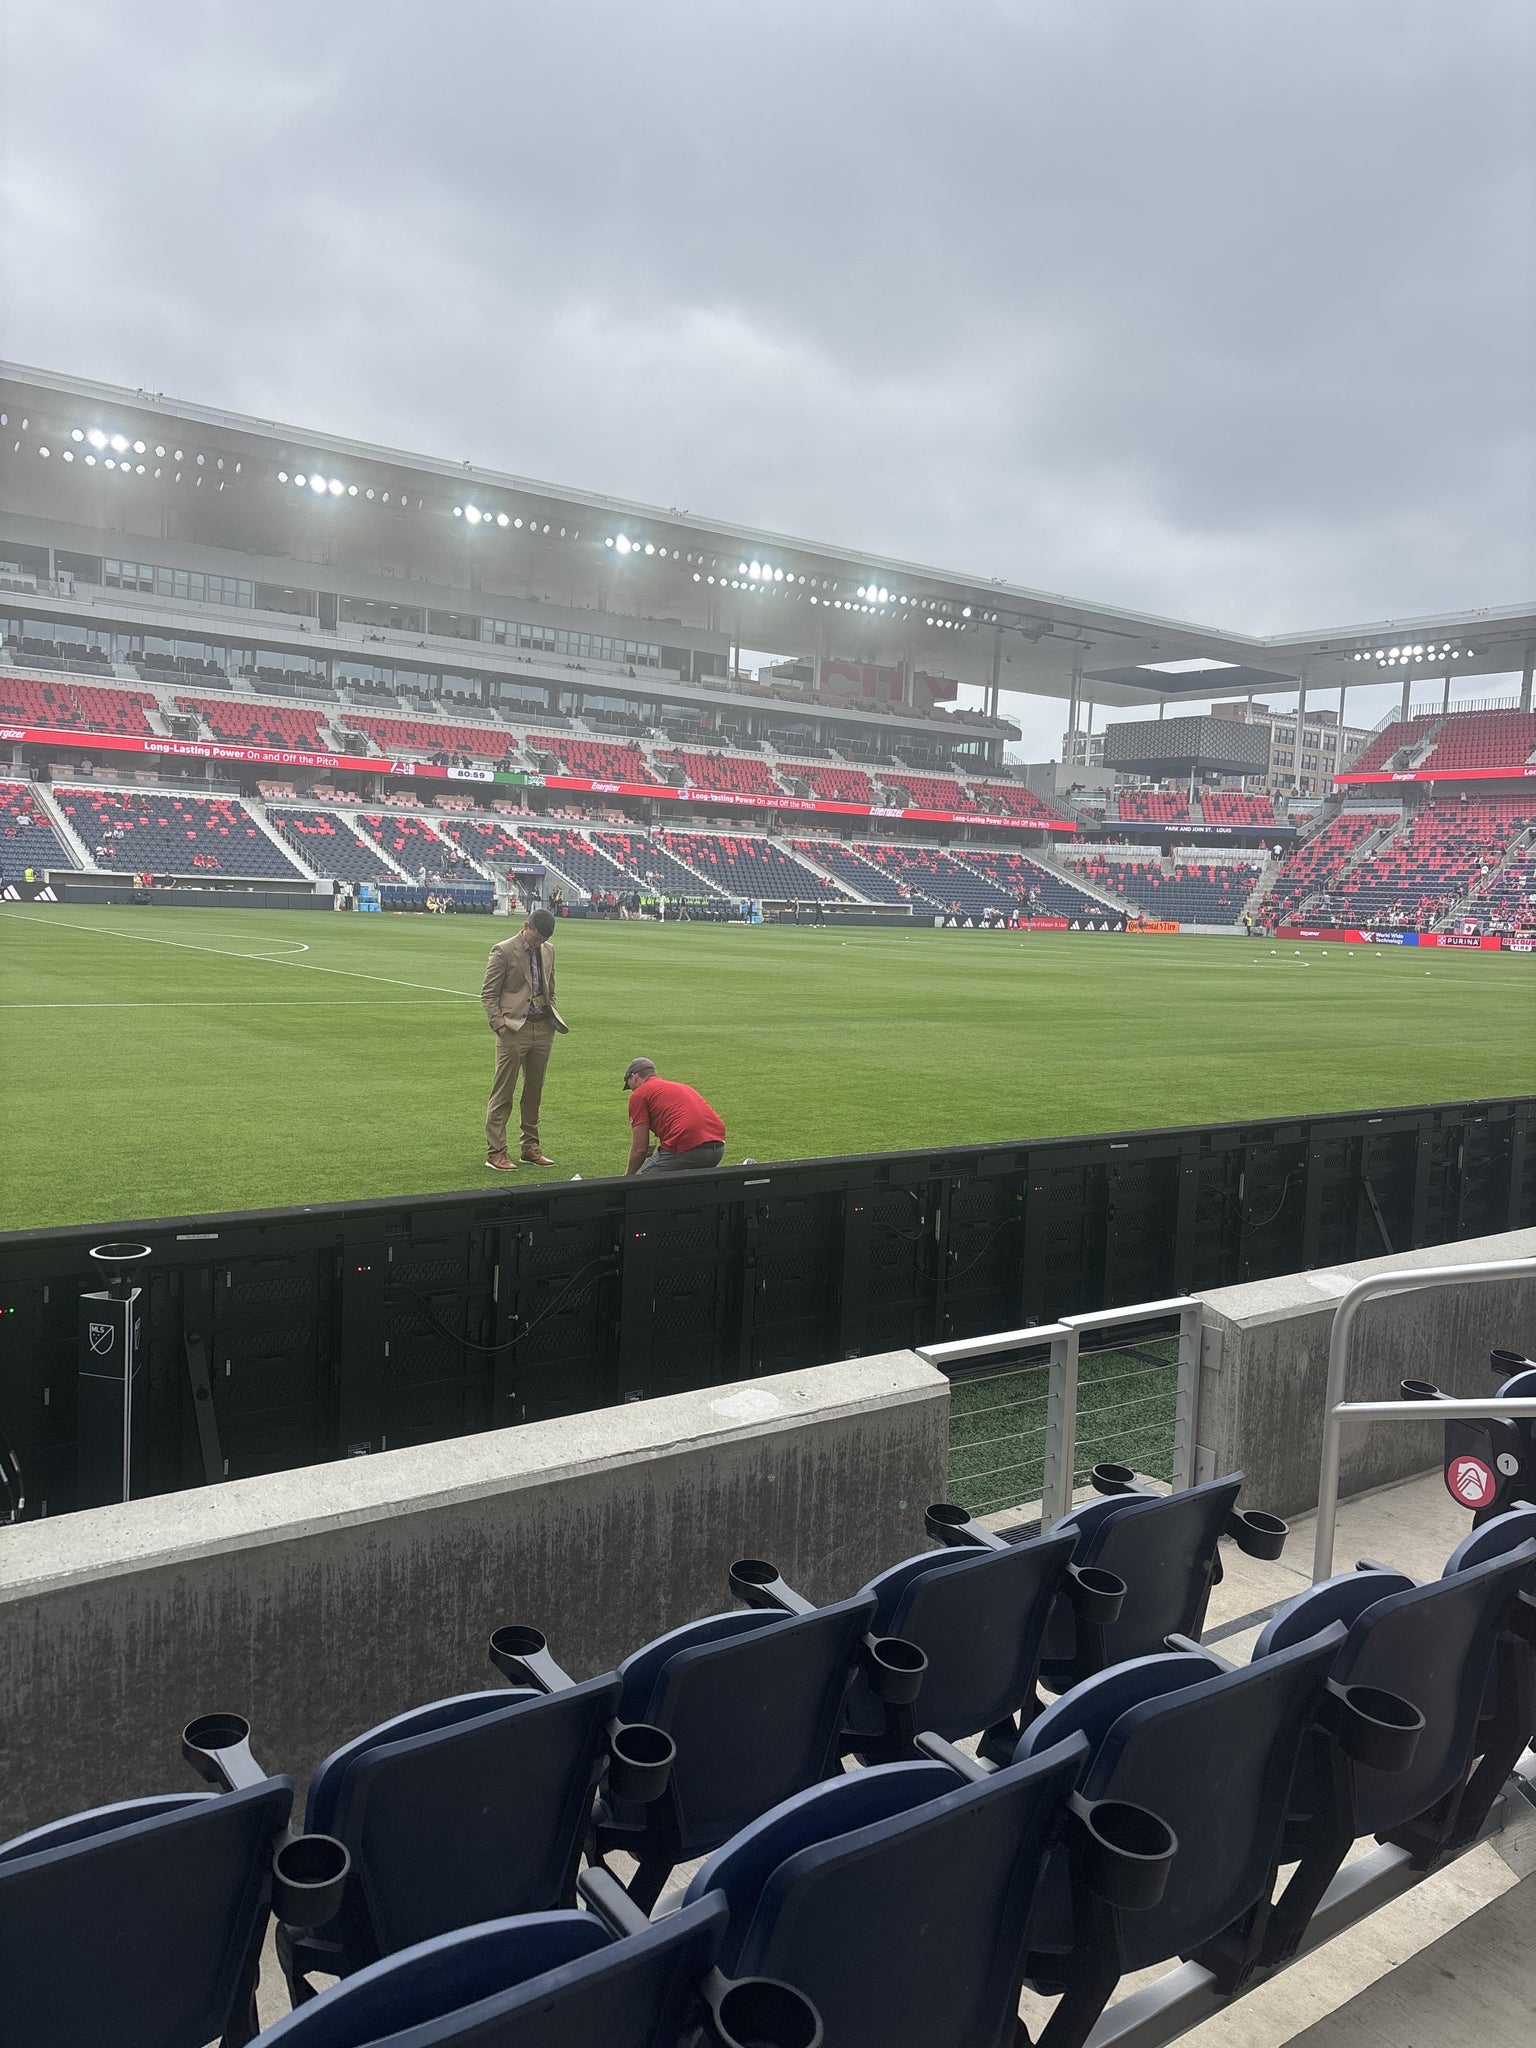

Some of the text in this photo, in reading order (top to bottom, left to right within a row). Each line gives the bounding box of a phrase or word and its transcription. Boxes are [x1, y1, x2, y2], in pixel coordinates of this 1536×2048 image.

[144, 741, 339, 766] Long-Lasting Power On and Off the Pitch
[457, 771, 486, 779] 80:59
[1392, 773, 1416, 781] Energizer
[591, 781, 621, 792] Energizer
[735, 796, 757, 805] Power
[757, 797, 765, 805] On
[767, 798, 778, 806] and
[780, 799, 789, 807] Off
[790, 800, 799, 808] the
[801, 801, 816, 809] Pitch
[869, 806, 904, 818] Energizer
[952, 814, 985, 824] Long-Lasting
[986, 816, 1002, 825] Power
[1037, 820, 1050, 828] Pitch
[1163, 922, 1176, 931] Tire
[1375, 937, 1404, 945] Technology
[1447, 937, 1479, 946] PURINA
[1504, 1459, 1509, 1470] 1
